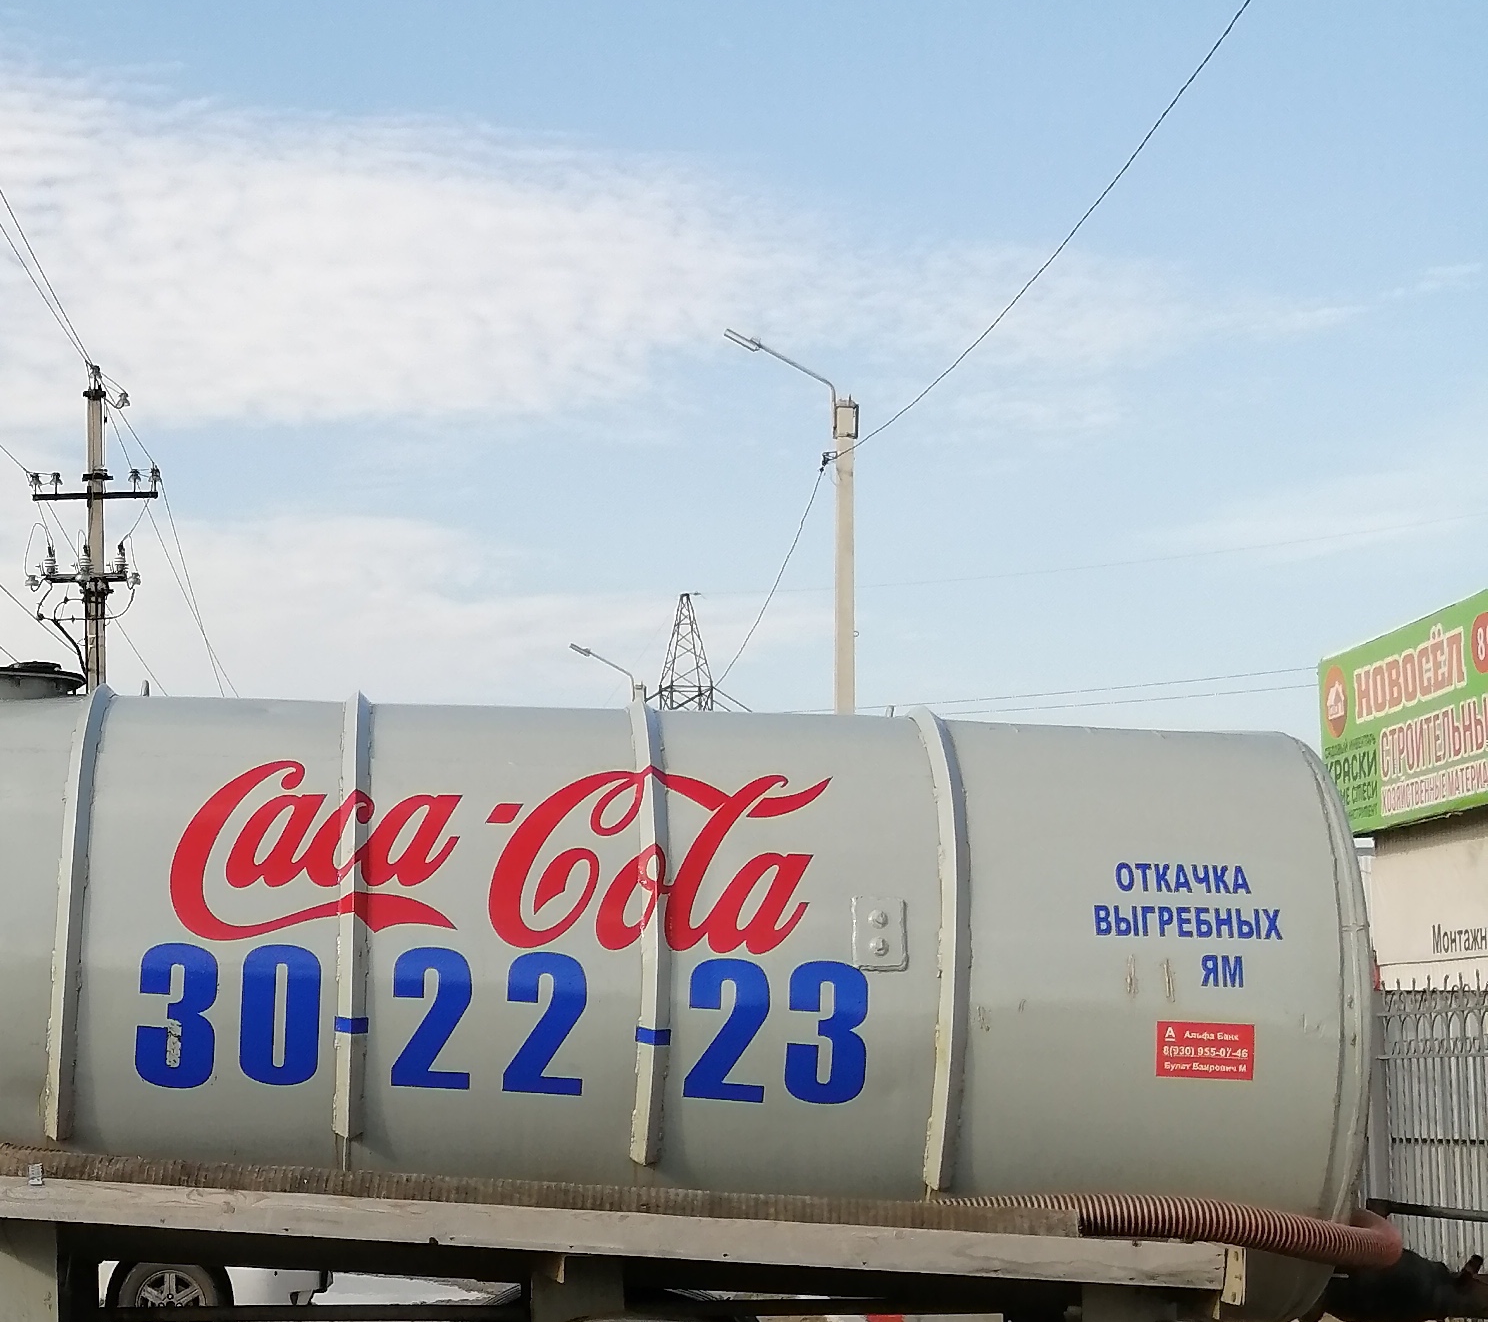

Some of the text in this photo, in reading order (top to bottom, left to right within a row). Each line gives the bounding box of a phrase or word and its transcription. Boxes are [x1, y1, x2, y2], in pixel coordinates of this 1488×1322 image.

[1354, 625, 1467, 722] НОВОСЁЛ
[1115, 862, 1252, 894] ОТКАЧКА
[1094, 905, 1283, 940] ВЫГРЕБНЫХ
[1202, 954, 1244, 988] ЯМ
[134, 942, 869, 1106] 30-22-23
[1184, 1030, 1239, 1042] Альфа Банк
